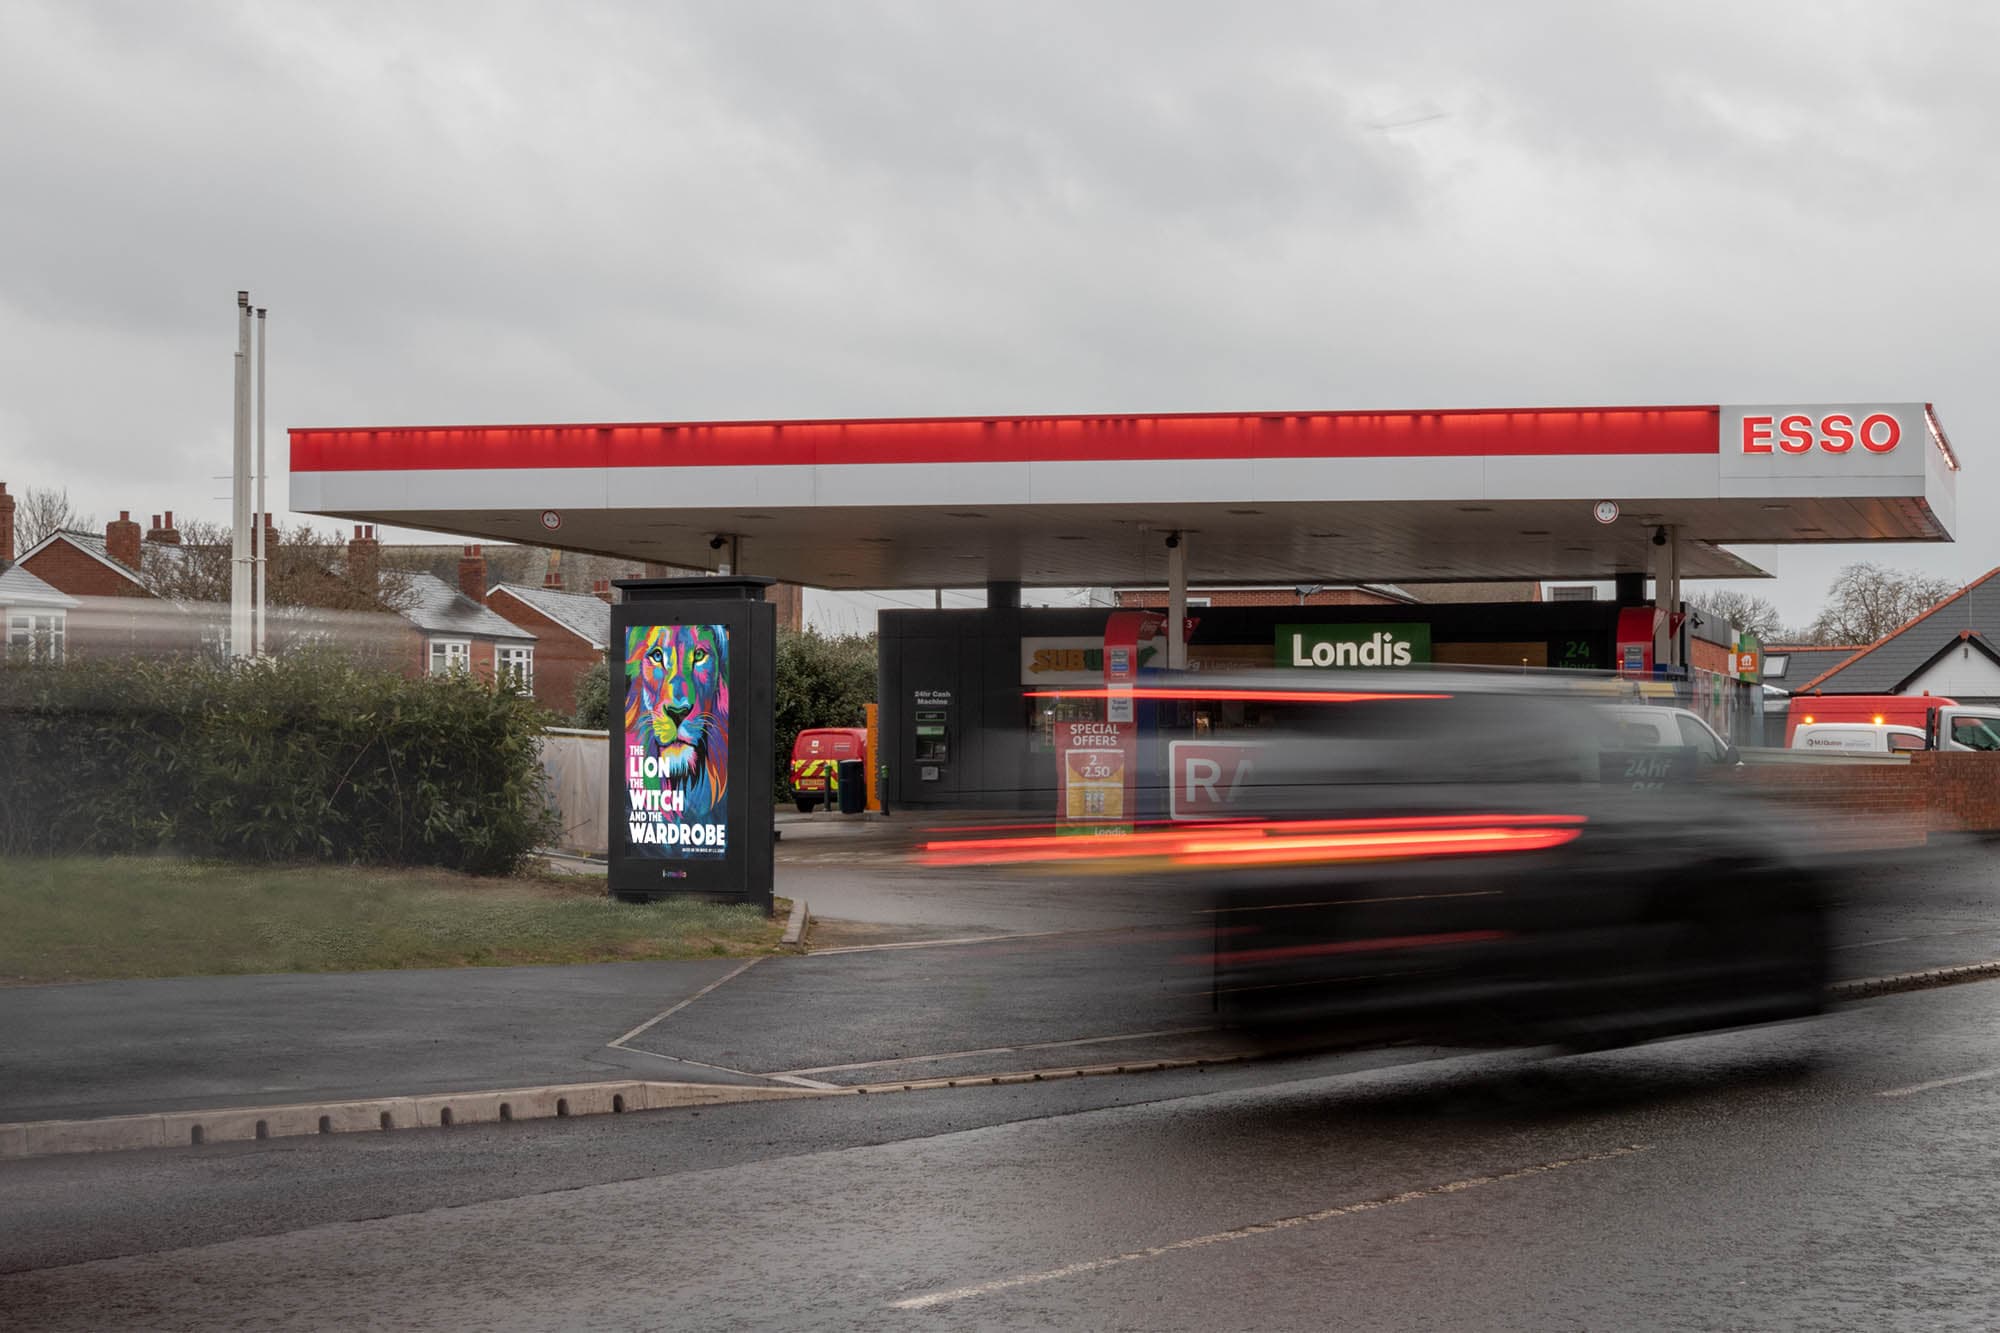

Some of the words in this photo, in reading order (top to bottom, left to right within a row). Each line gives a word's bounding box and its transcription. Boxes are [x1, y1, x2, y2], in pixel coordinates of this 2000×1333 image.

[1742, 413, 1902, 454] ESSO
[1186, 619, 1193, 629] 3
[1293, 632, 1412, 667] Londis
[1566, 641, 1590, 658] 24
[1070, 724, 1120, 735] SPECIAL
[1072, 735, 1117, 746] OFFERS
[629, 745, 644, 755] THE
[1089, 754, 1097, 765] 2
[629, 756, 670, 778] LION
[629, 778, 644, 788] THE
[629, 790, 684, 811] WITCH
[629, 812, 646, 822] AND
[648, 812, 662, 822] THE
[629, 823, 725, 846] WARDROBE
